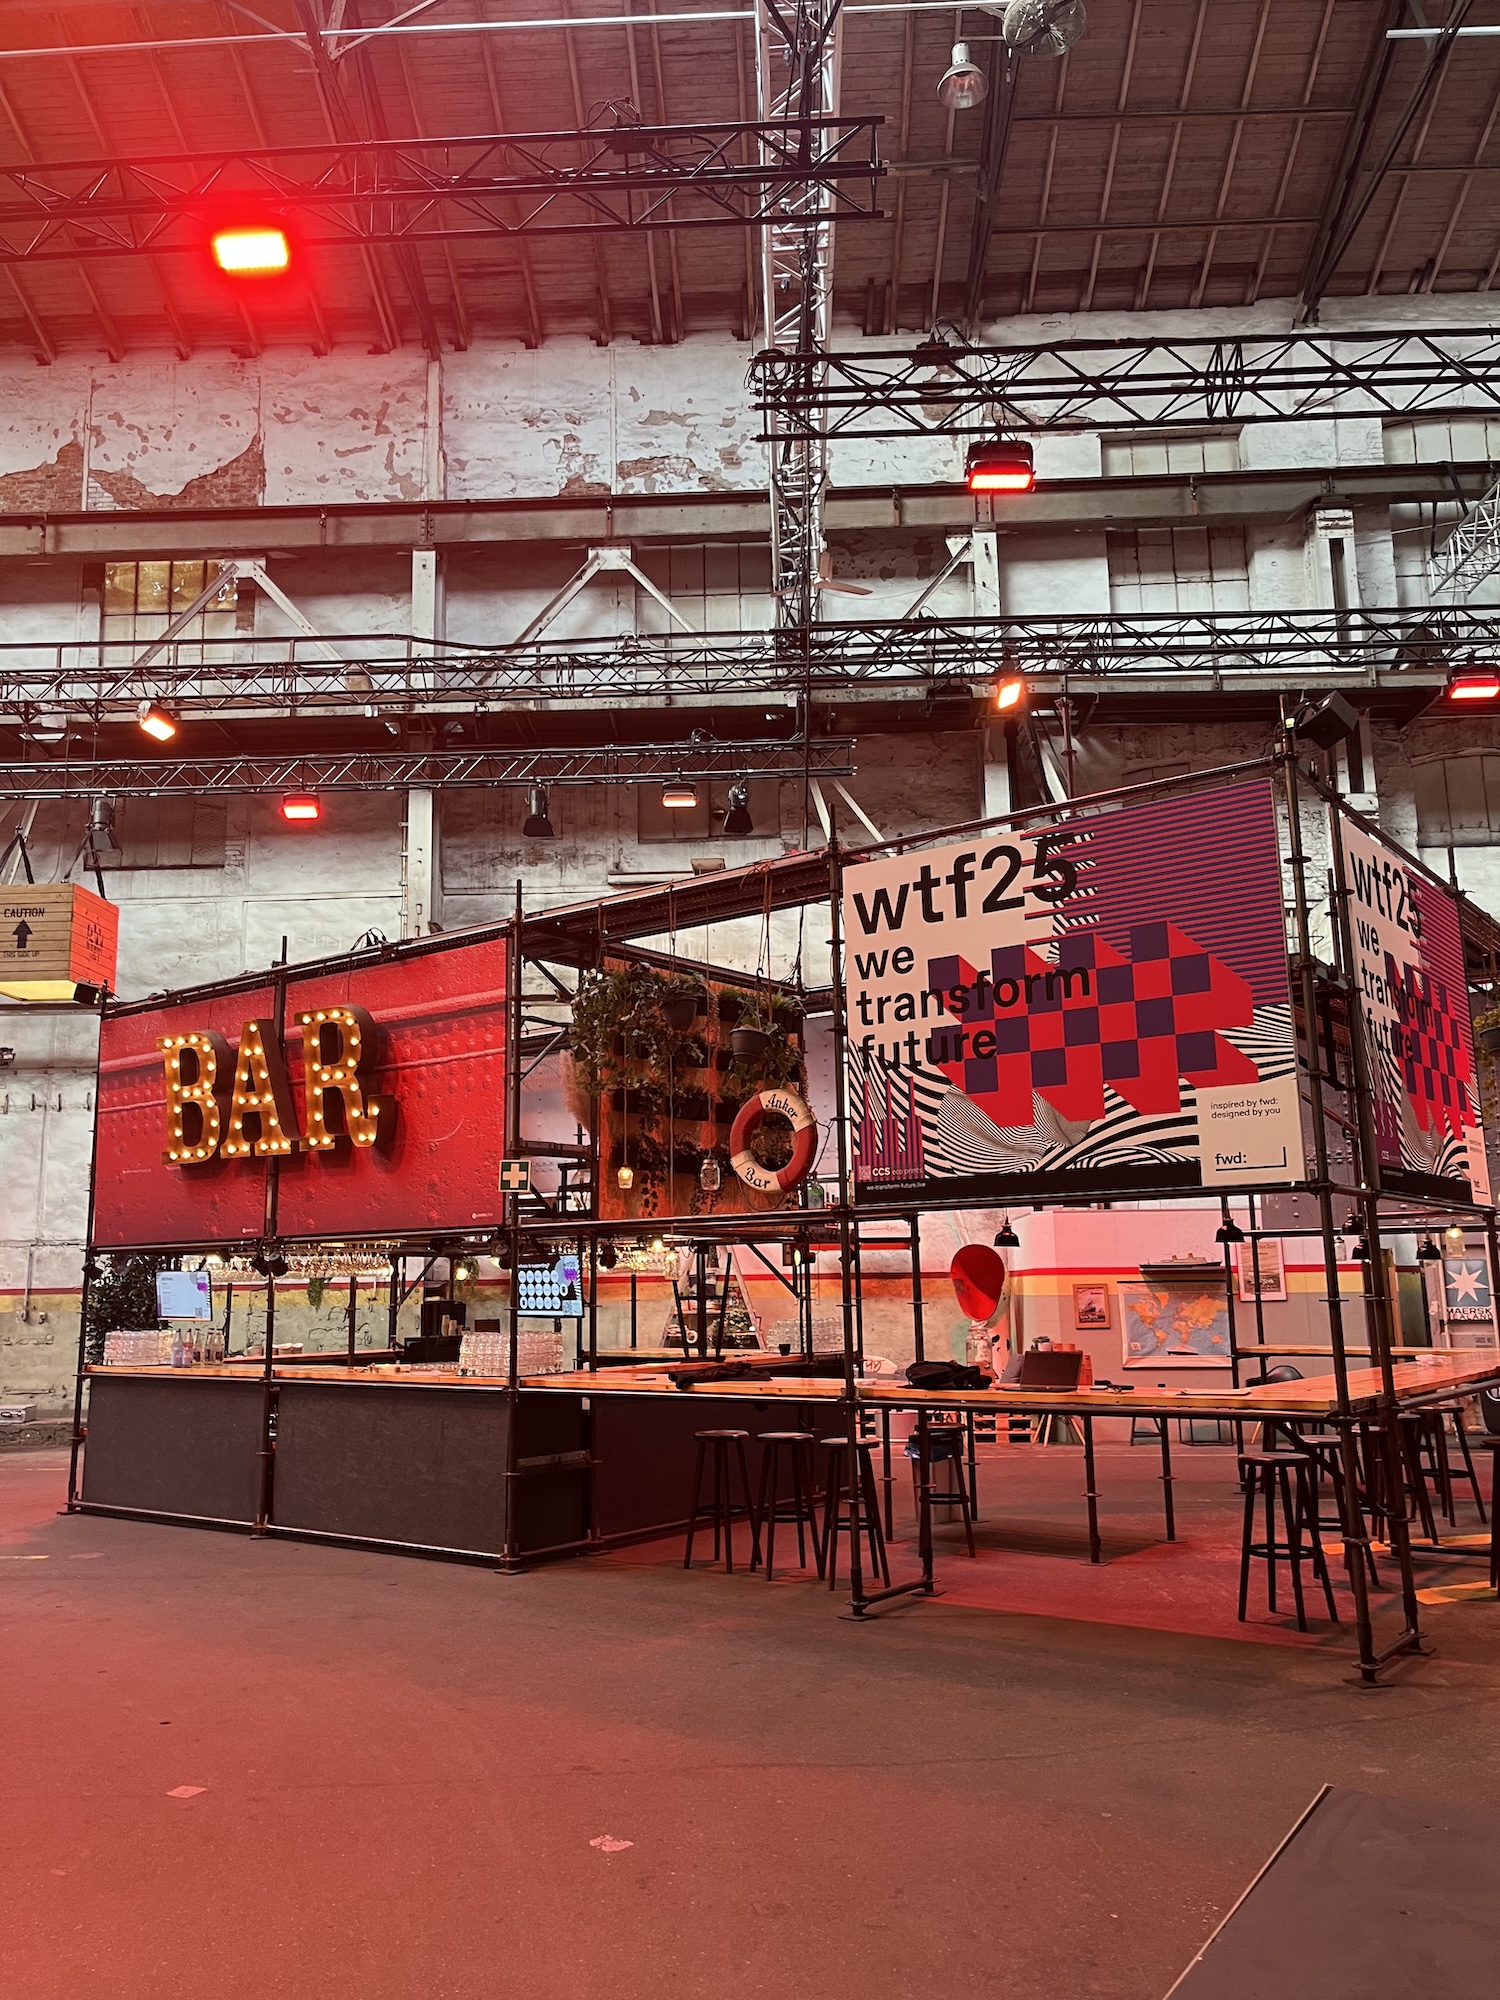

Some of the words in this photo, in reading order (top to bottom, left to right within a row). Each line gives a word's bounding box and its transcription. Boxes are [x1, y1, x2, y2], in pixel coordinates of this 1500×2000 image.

[852, 832, 1078, 936] wtf25
[1350, 851, 1421, 939] wtf25
[3, 908, 45, 918] CAUTION
[1356, 916, 1381, 956] we
[854, 945, 915, 980] we
[856, 966, 1091, 1026] transform
[1361, 958, 1435, 1030] transform
[858, 1029, 998, 1071] future
[1366, 1007, 1414, 1062] future
[156, 1005, 386, 1166] BAR
[765, 1093, 798, 1118] Anker
[1210, 1100, 1245, 1110] inspired
[1246, 1099, 1257, 1108] by
[1259, 1097, 1279, 1106] fwd:
[1211, 1109, 1250, 1119] designed
[1252, 1108, 1263, 1117] by
[1265, 1107, 1281, 1117] you
[872, 1167, 891, 1177] CCS
[905, 1167, 924, 1176] prints
[1214, 1151, 1247, 1165] fwd:
[744, 1167, 771, 1189] Bar
[1447, 1307, 1492, 1315] MAERSK
